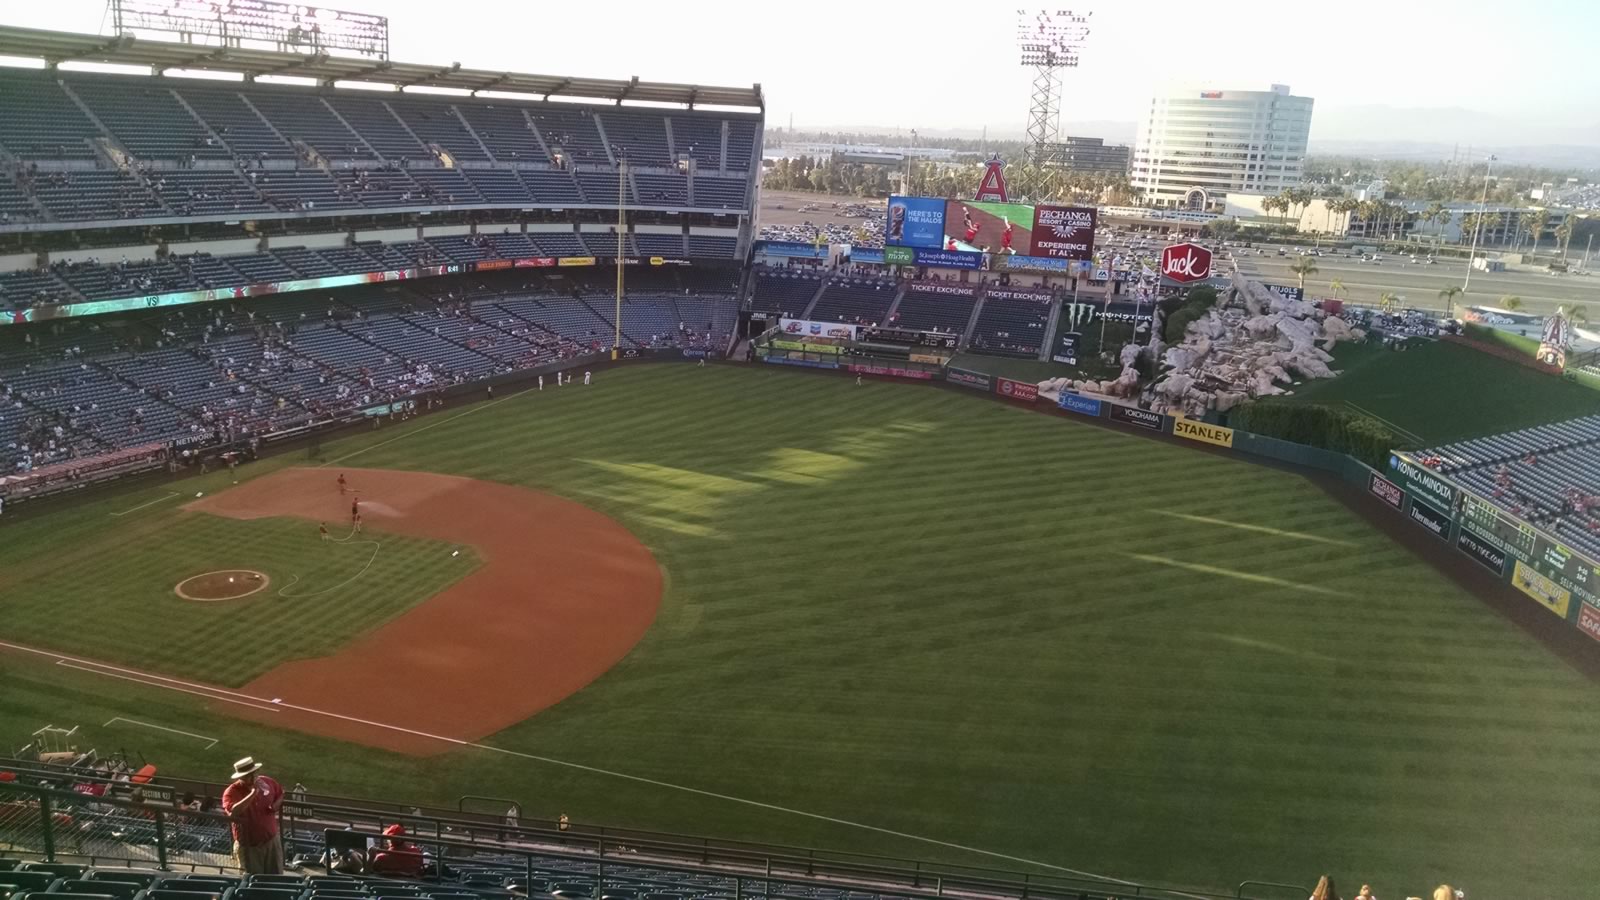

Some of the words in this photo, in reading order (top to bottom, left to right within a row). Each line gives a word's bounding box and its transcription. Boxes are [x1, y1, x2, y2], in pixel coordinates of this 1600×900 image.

[1040, 210, 1091, 221] PECHANGA
[1038, 241, 1087, 251] EXPERIENCE
[1163, 248, 1208, 277] Jack
[911, 284, 935, 292] TICKET
[987, 290, 1012, 298] TICKET
[1095, 306, 1152, 321] MONSTER
[1067, 399, 1096, 411] Experian
[1124, 409, 1159, 422] YOKOHAMA
[1176, 421, 1231, 442] STANLEY
[176, 432, 215, 446] NETWORK
[1397, 461, 1422, 483] KONICA
[1421, 474, 1452, 500] MINOLTA
[1411, 506, 1442, 533] Thermador
